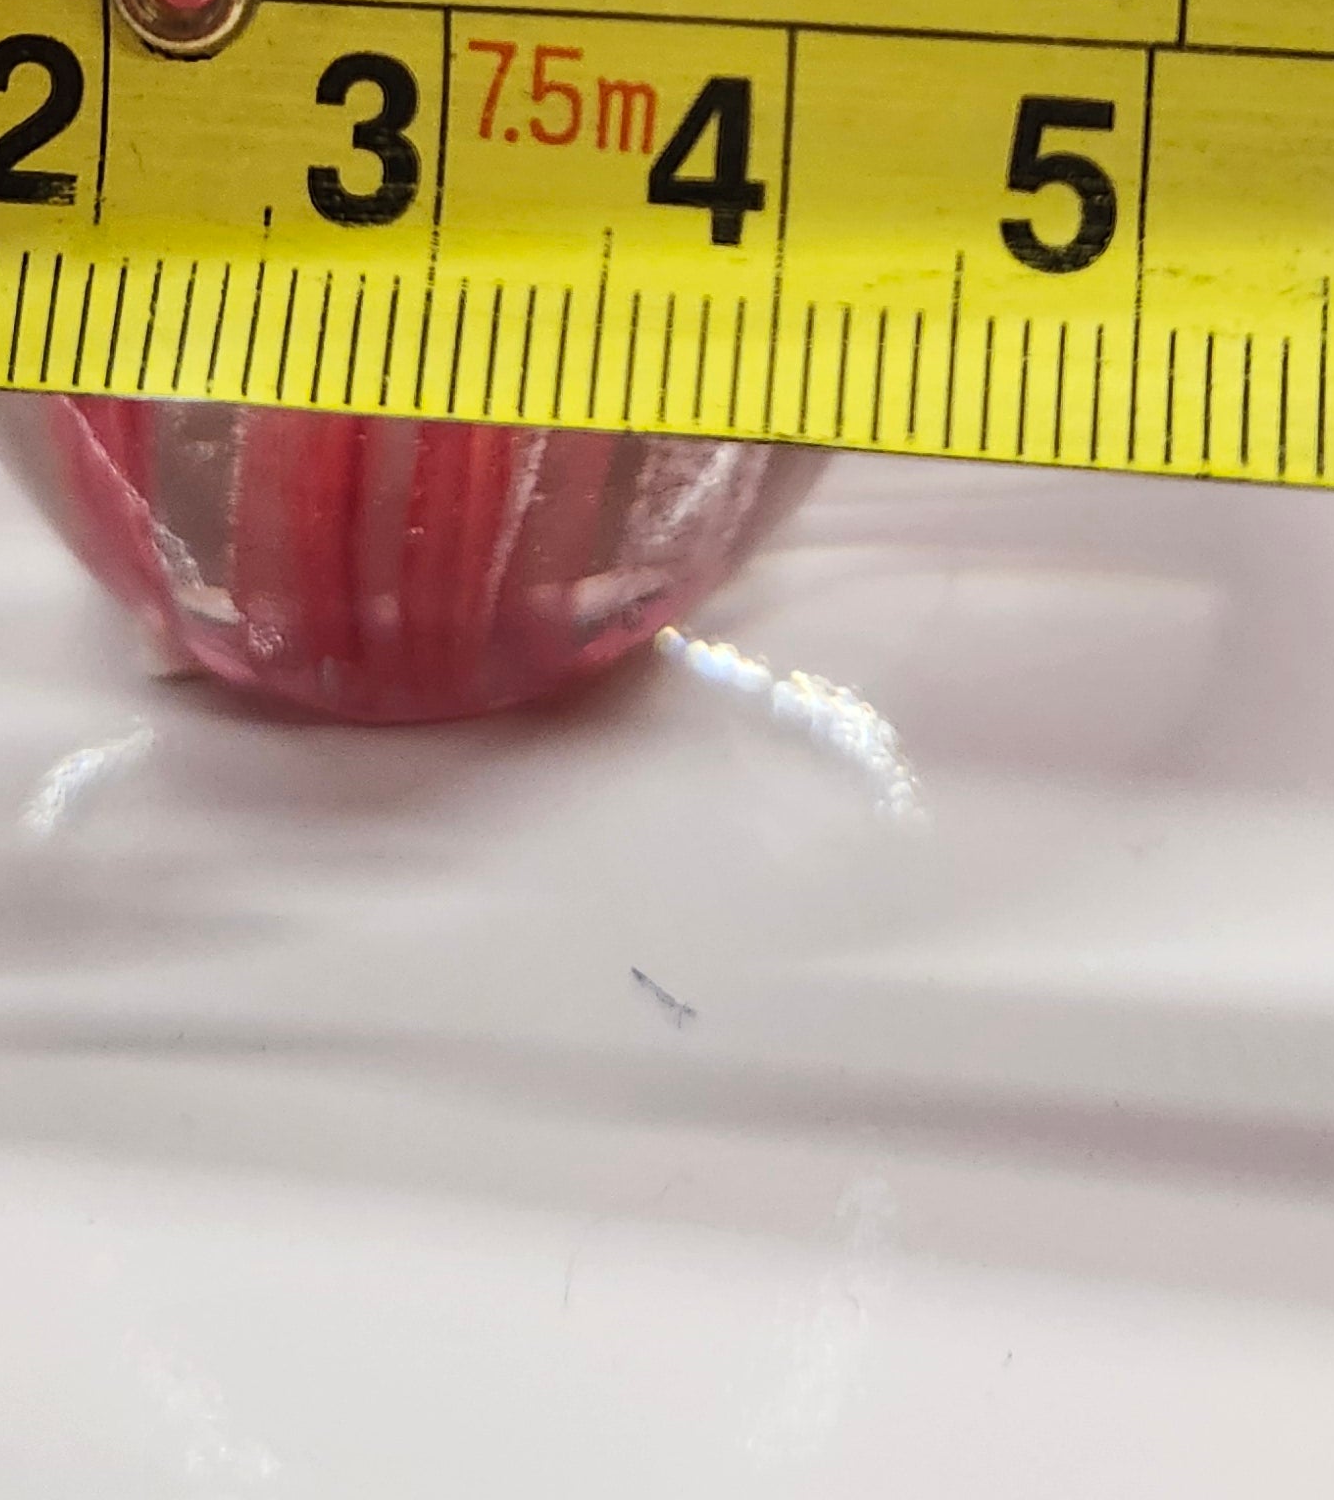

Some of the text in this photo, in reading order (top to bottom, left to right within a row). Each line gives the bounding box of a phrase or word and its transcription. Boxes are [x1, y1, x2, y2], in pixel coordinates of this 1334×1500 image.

[307, 51, 421, 227] 3
[467, 38, 660, 155] 7.5m
[646, 75, 766, 247] 4
[998, 94, 1118, 275] 5
